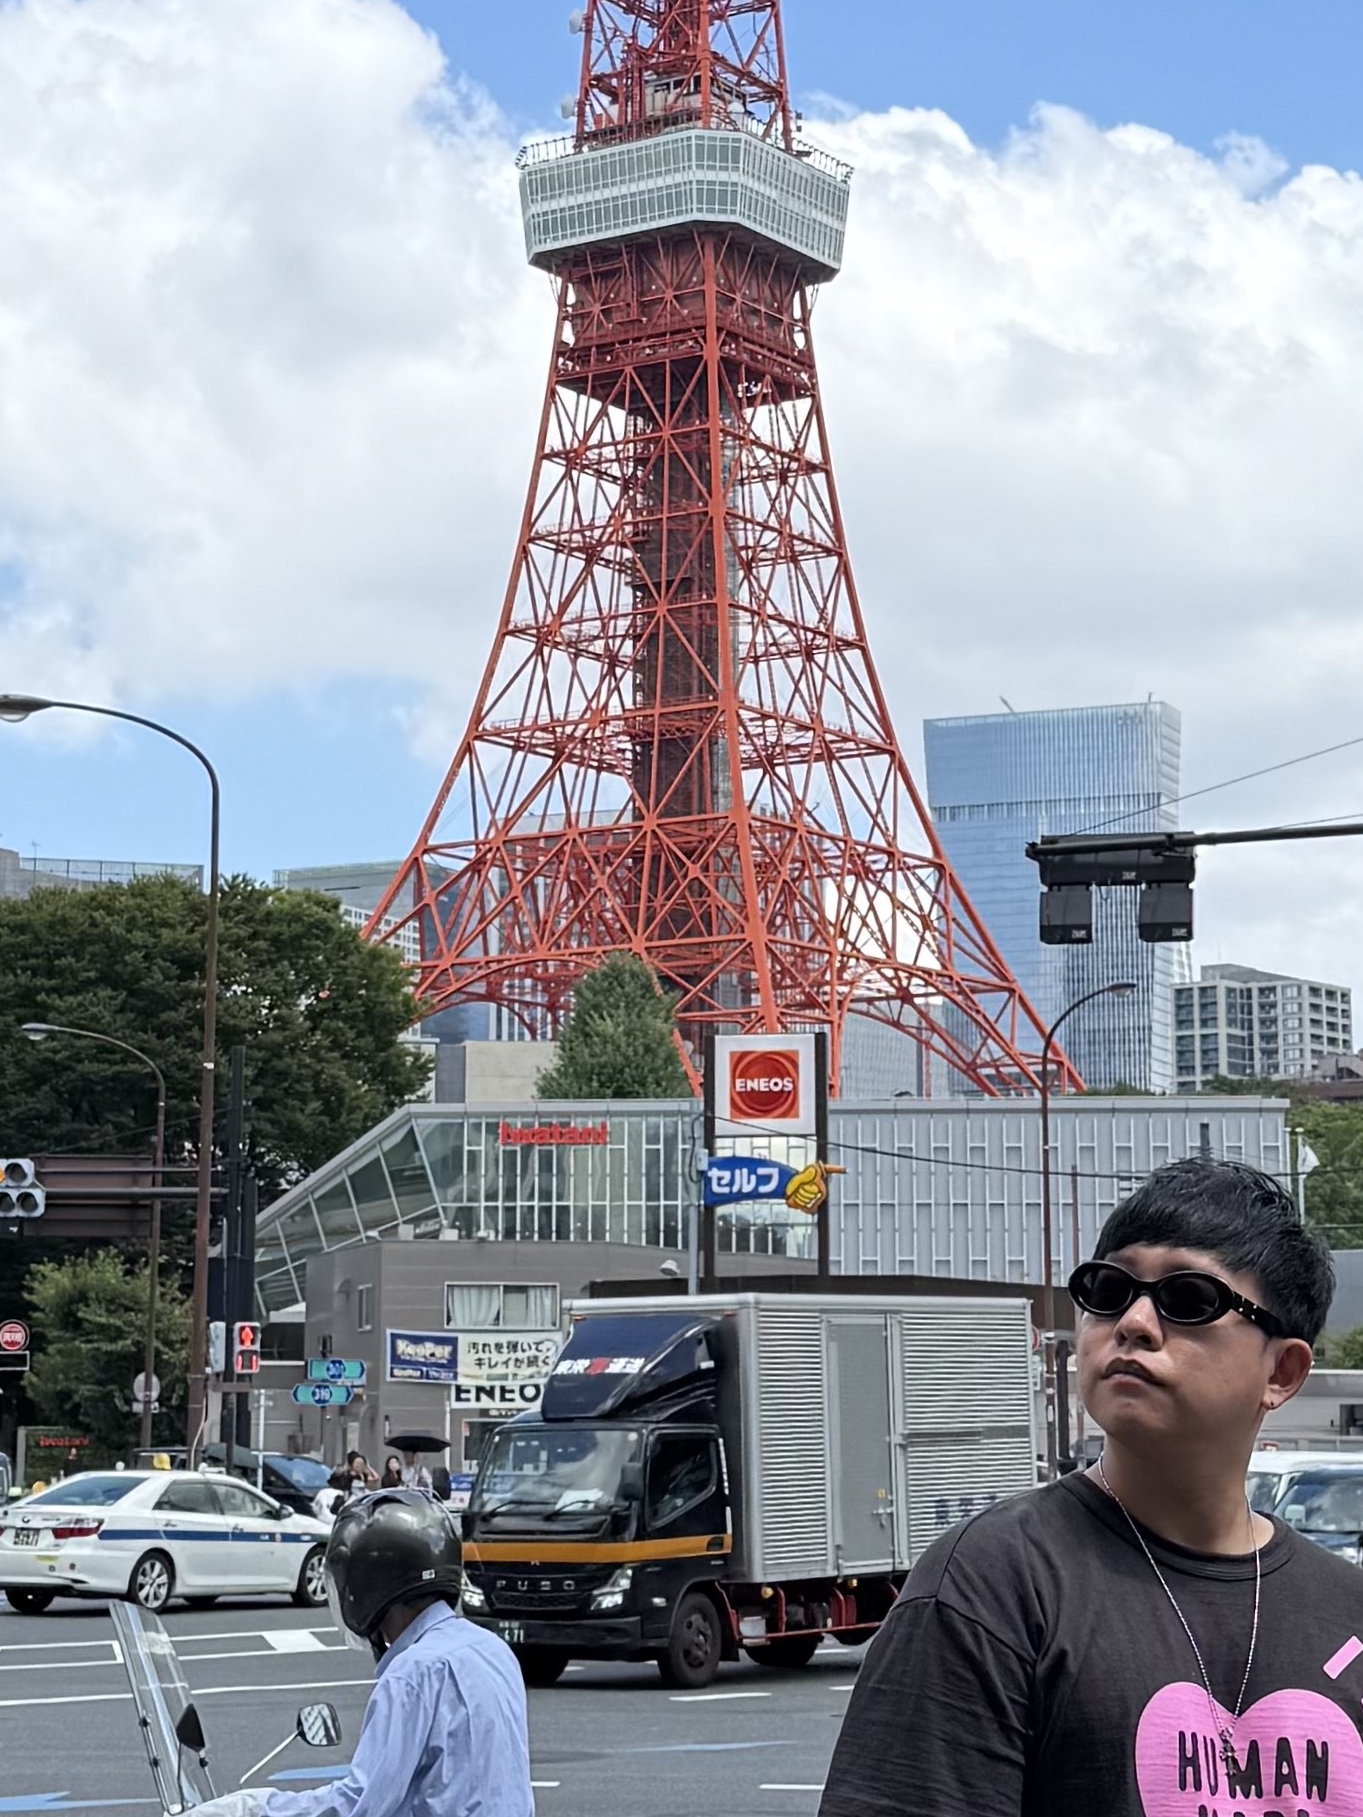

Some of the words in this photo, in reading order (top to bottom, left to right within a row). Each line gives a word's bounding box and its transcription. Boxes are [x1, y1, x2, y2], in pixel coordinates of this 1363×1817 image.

[735, 1078, 794, 1092] ENEOS
[707, 1167, 780, 1195] セルフ
[1178, 1730, 1329, 1803] HUMAN
